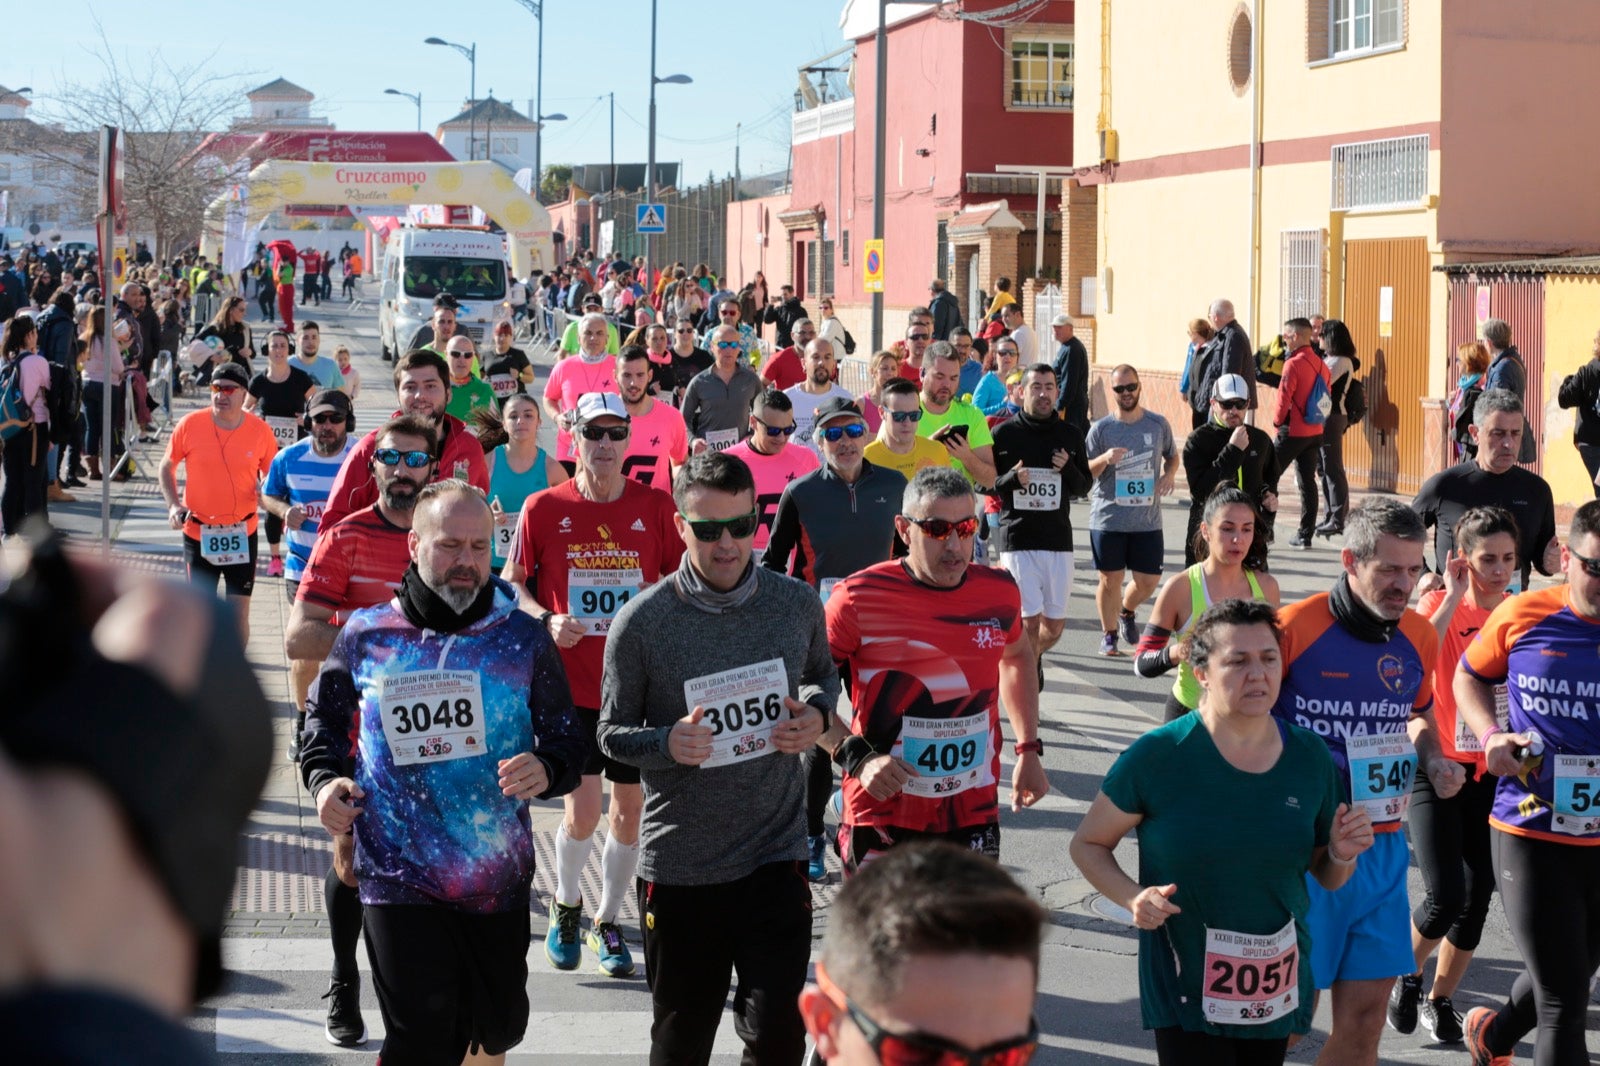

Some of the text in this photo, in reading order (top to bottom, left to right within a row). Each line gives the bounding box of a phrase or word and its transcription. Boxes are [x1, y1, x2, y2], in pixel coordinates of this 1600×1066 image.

[332, 140, 386, 152] Diputación
[333, 153, 387, 161] de Granada
[335, 168, 427, 185] Cruzcampo
[344, 188, 388, 201] Radler
[493, 380, 518, 392] 2073
[270, 427, 294, 439] 052
[1127, 481, 1145, 495] 63
[209, 535, 241, 552] 895
[566, 550, 639, 559] MADRID
[581, 590, 630, 614] 901
[400, 676, 417, 685] GRAN
[418, 673, 442, 683] PREMIO
[442, 672, 451, 680] DE
[427, 681, 436, 689] DE
[435, 680, 462, 688] GRANADA
[690, 663, 779, 691] XXXIII GRAN PREMIO DE FONDO
[736, 681, 745, 689] DE
[744, 676, 769, 687] GRANADA
[1517, 673, 1571, 696] DONA
[1295, 694, 1355, 717] DONA
[1519, 691, 1589, 721] DONA
[391, 698, 474, 735] 3048
[703, 693, 781, 737] 3056
[909, 719, 925, 728] XXXIII
[926, 721, 942, 729] GRAN
[943, 719, 964, 729] PREMIO
[964, 719, 972, 727] DE
[1294, 713, 1368, 738] DONA
[917, 739, 977, 773] 409
[1367, 759, 1412, 794] 549
[1214, 932, 1233, 944] XXXIII
[1234, 935, 1252, 946] GRAN
[1209, 951, 1296, 996] 2057
